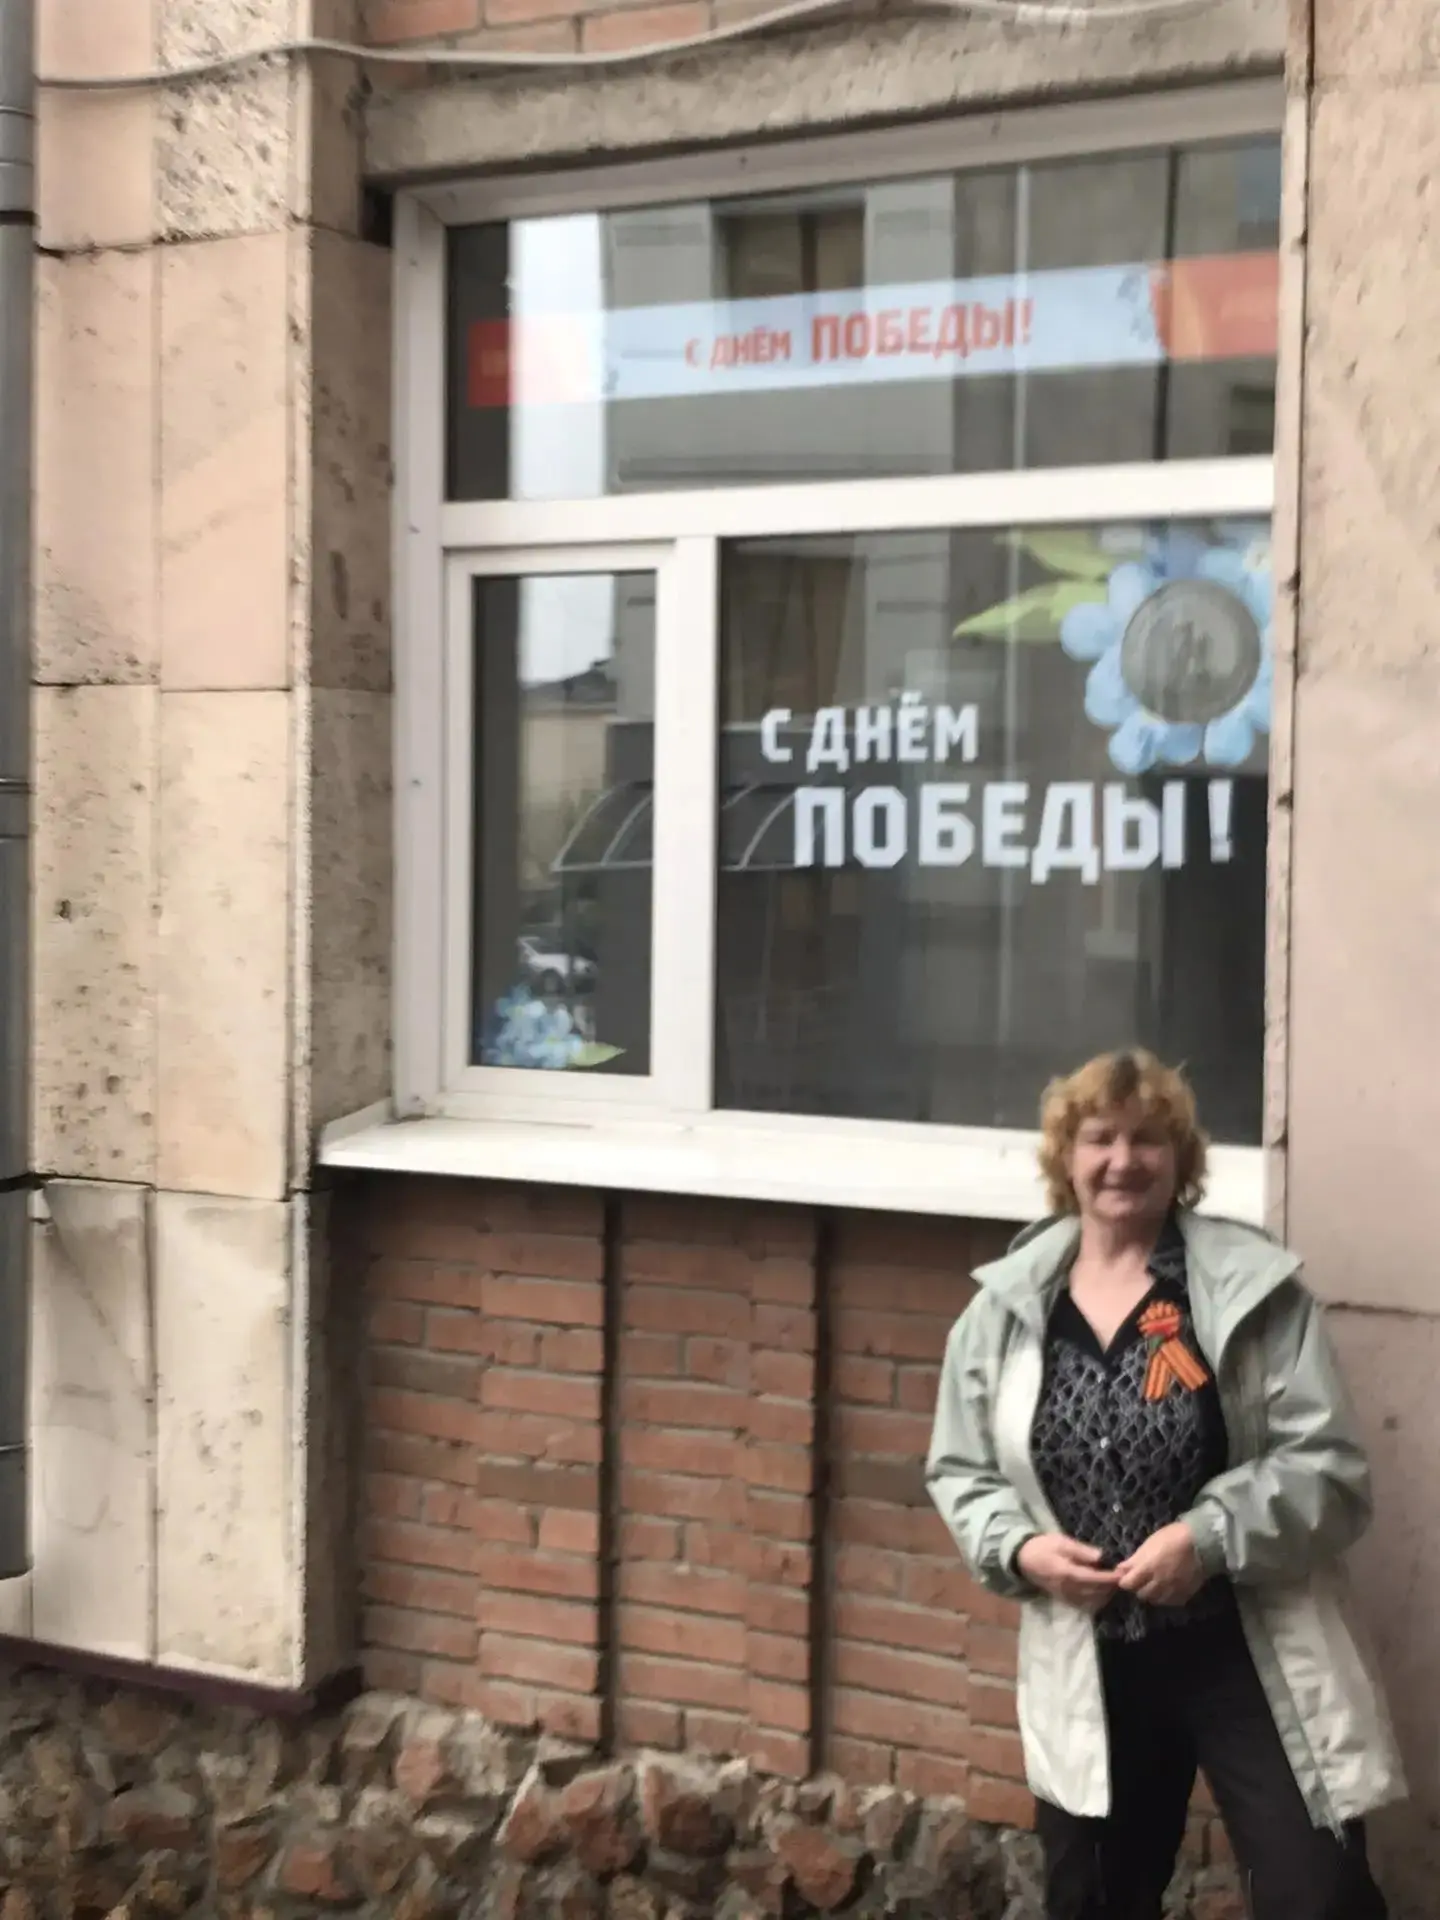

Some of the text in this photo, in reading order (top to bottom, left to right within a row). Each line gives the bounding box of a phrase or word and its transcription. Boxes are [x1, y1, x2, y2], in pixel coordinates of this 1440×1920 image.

[684, 297, 1034, 371] С ДНЁМ ПОБЕДЫ!
[761, 690, 980, 772] С ДНЁМ
[794, 779, 1233, 885] ПОБЕДЫ!
